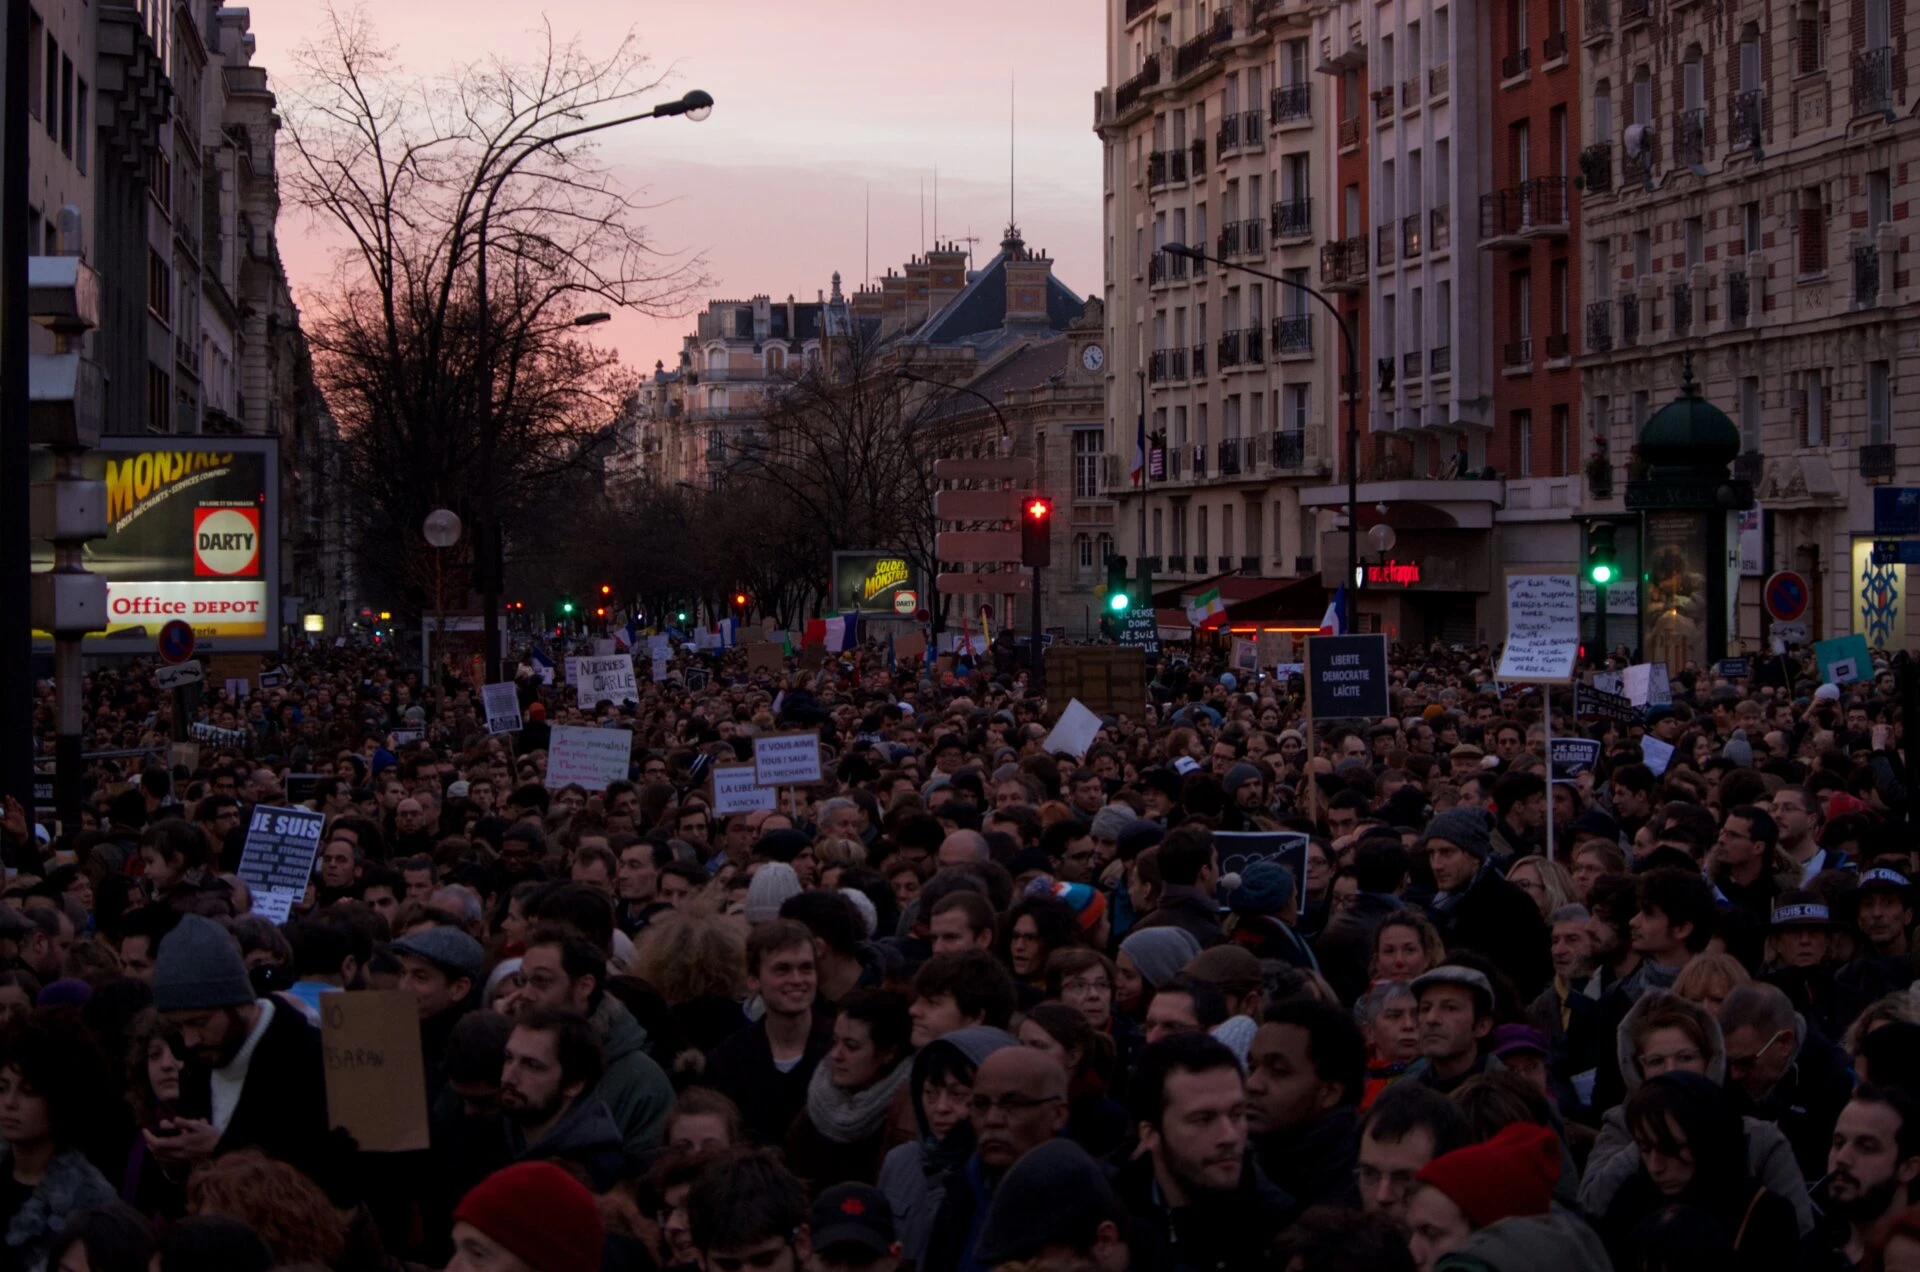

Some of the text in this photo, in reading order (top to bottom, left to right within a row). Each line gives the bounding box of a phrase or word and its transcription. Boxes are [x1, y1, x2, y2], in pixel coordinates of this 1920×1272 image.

[199, 533, 253, 550] DARTY
[875, 560, 905, 576] SOLDES
[864, 569, 908, 601] MONSTRES
[113, 598, 259, 615] Office DEPOT
[1132, 609, 1154, 618] PENSE
[1128, 620, 1151, 628] DONC
[1120, 630, 1154, 640] JE SUIS
[1322, 670, 1370, 682] DEMOCRATIE
[593, 673, 634, 692] CHARLIE
[1578, 703, 1597, 715] JE
[1598, 706, 1632, 722] SUIS
[758, 740, 815, 752] JE VOUS AIME
[1552, 744, 1593, 753] JE SUIS
[762, 757, 781, 765] TOUS
[1552, 752, 1593, 762] CHARLIE
[760, 769, 773, 778] LES
[721, 784, 732, 794] LA
[727, 799, 760, 808] VAINCRA
[249, 813, 272, 832] JE
[275, 815, 321, 839] SUIS
[1779, 904, 1801, 918] SUIS
